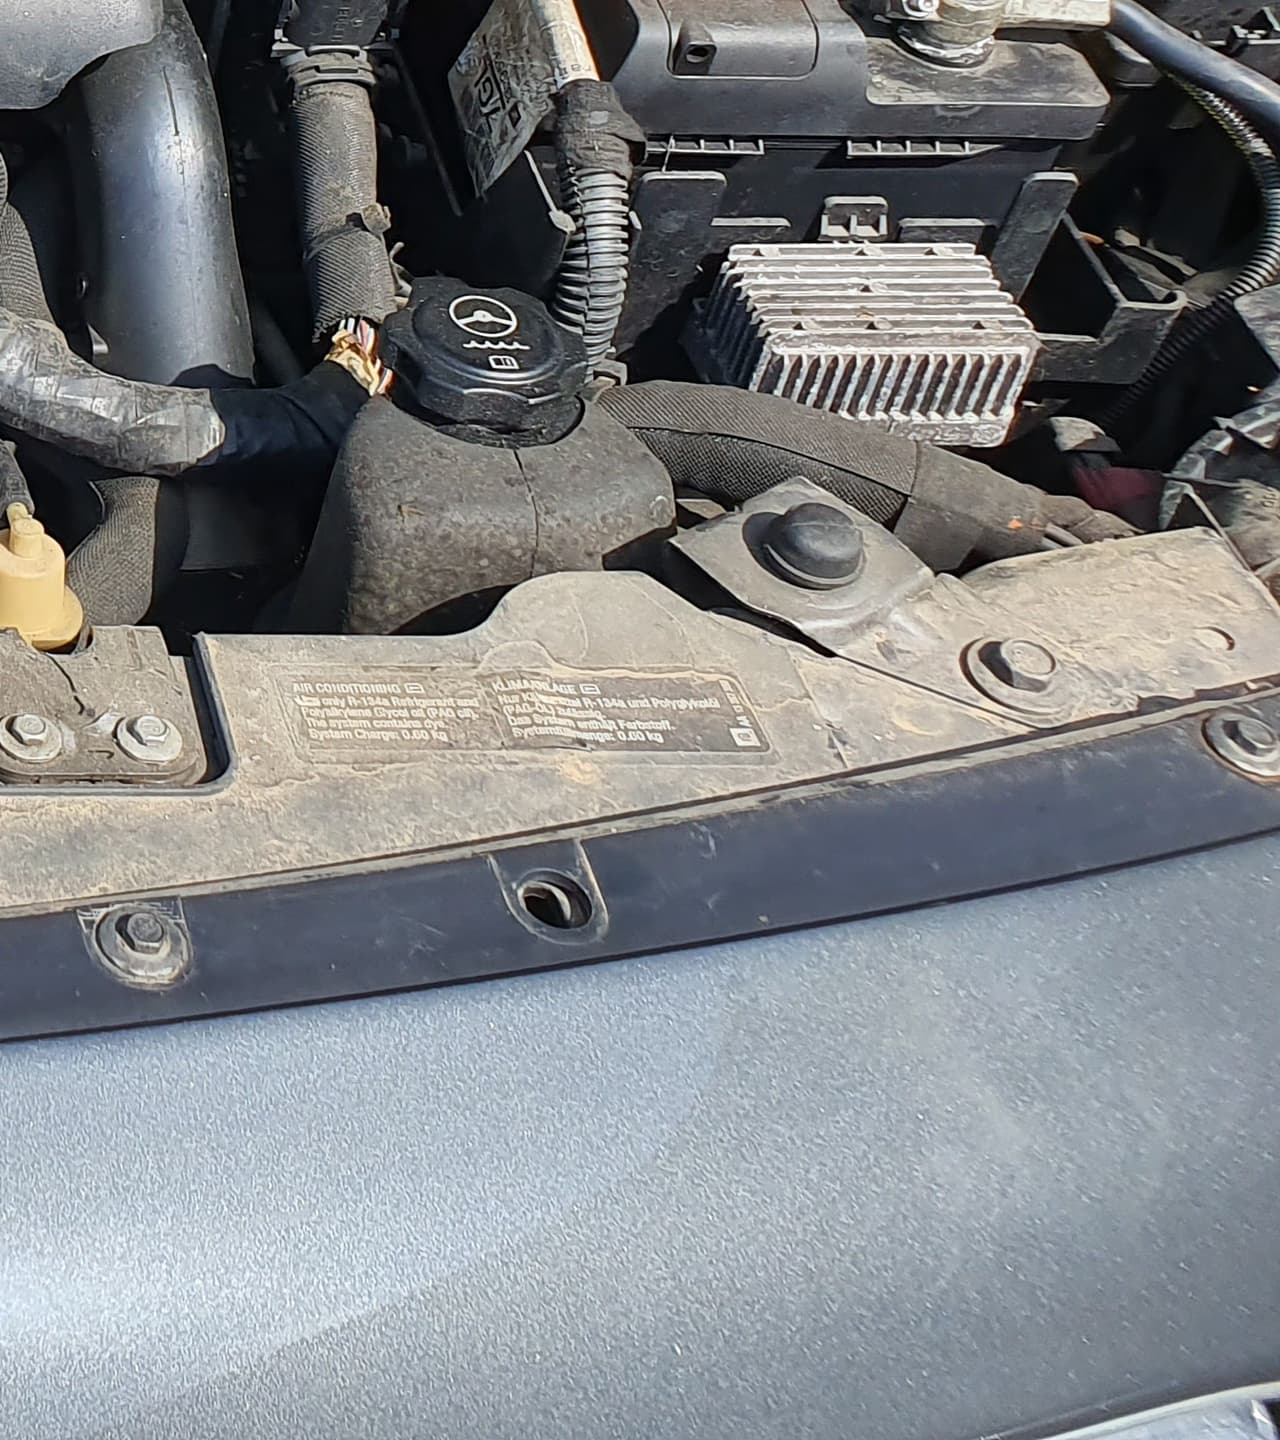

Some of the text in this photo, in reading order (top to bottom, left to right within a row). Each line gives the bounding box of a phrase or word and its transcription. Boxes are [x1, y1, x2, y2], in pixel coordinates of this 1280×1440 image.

[293, 683, 401, 694] AIR CONDITIONING
[347, 696, 390, 707] R-134a
[627, 697, 651, 708] und
[308, 729, 352, 741] System
